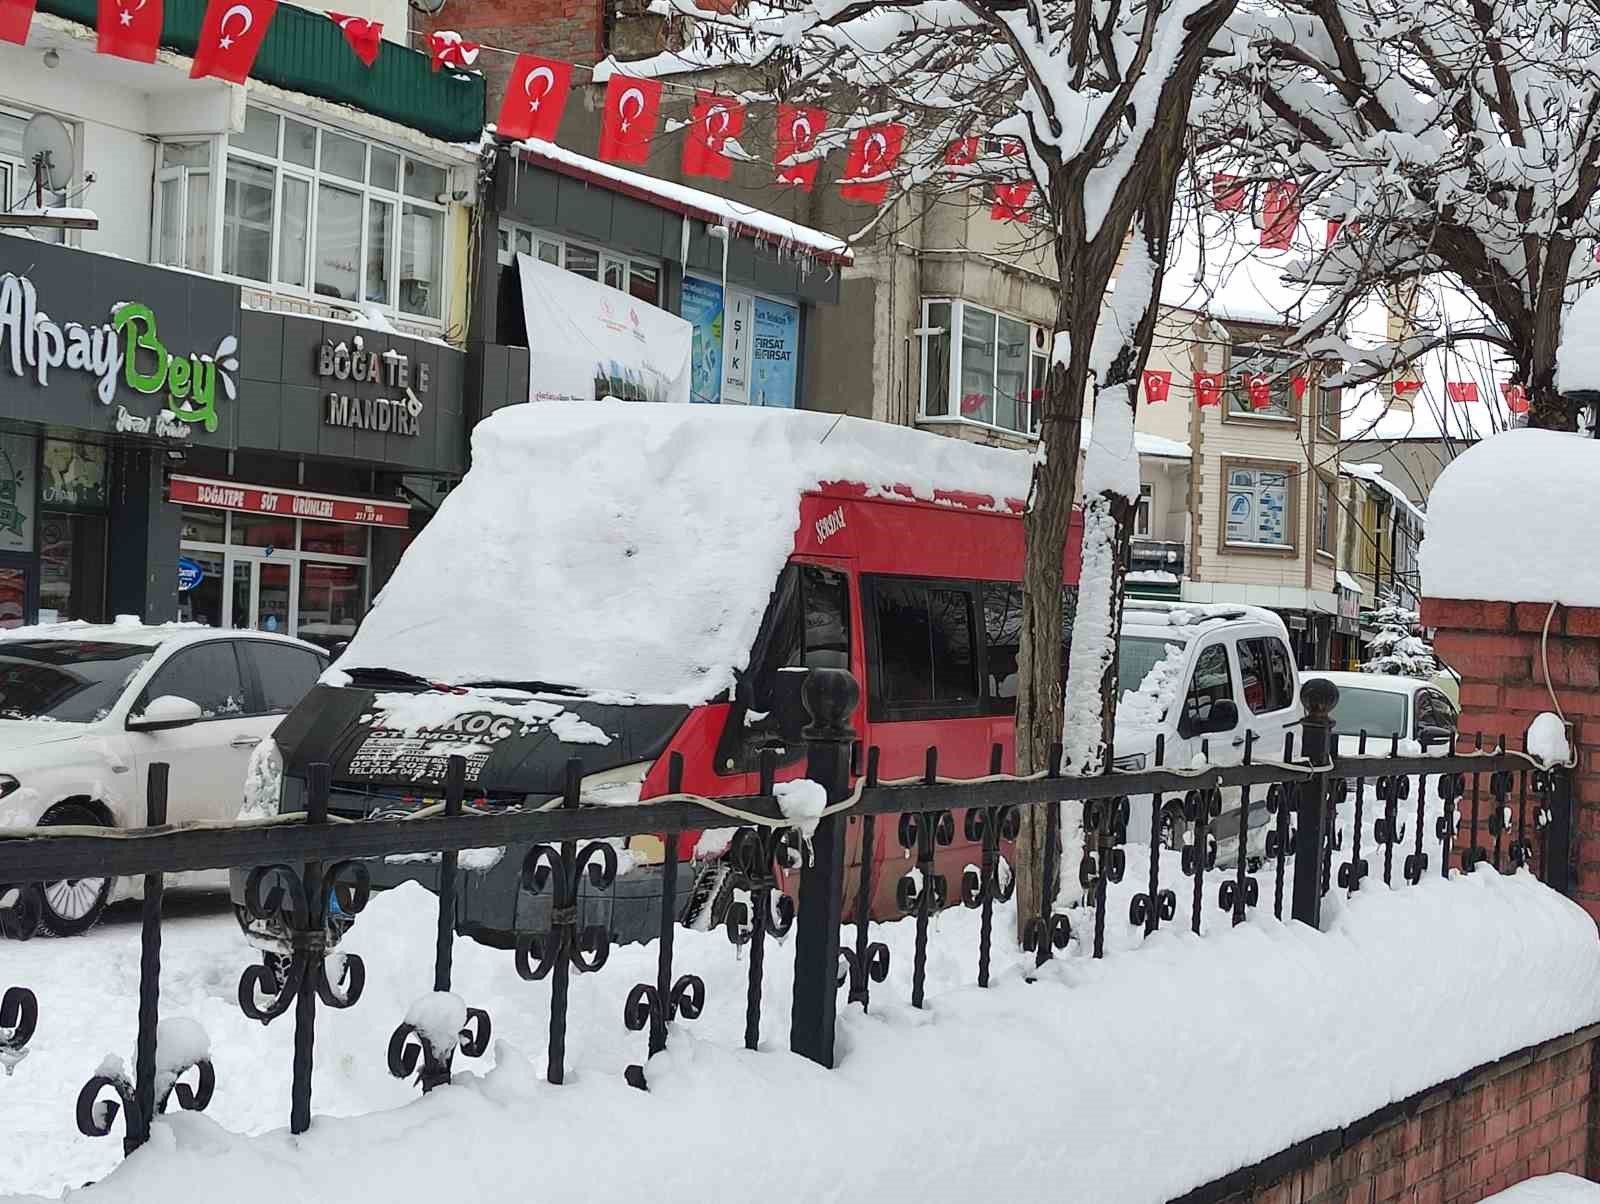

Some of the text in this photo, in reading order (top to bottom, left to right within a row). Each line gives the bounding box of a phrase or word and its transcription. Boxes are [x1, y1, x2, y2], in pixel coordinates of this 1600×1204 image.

[0, 273, 219, 433] Alpay Bey
[197, 485, 245, 507] BOĞATEPE
[350, 760, 392, 769] 0532
